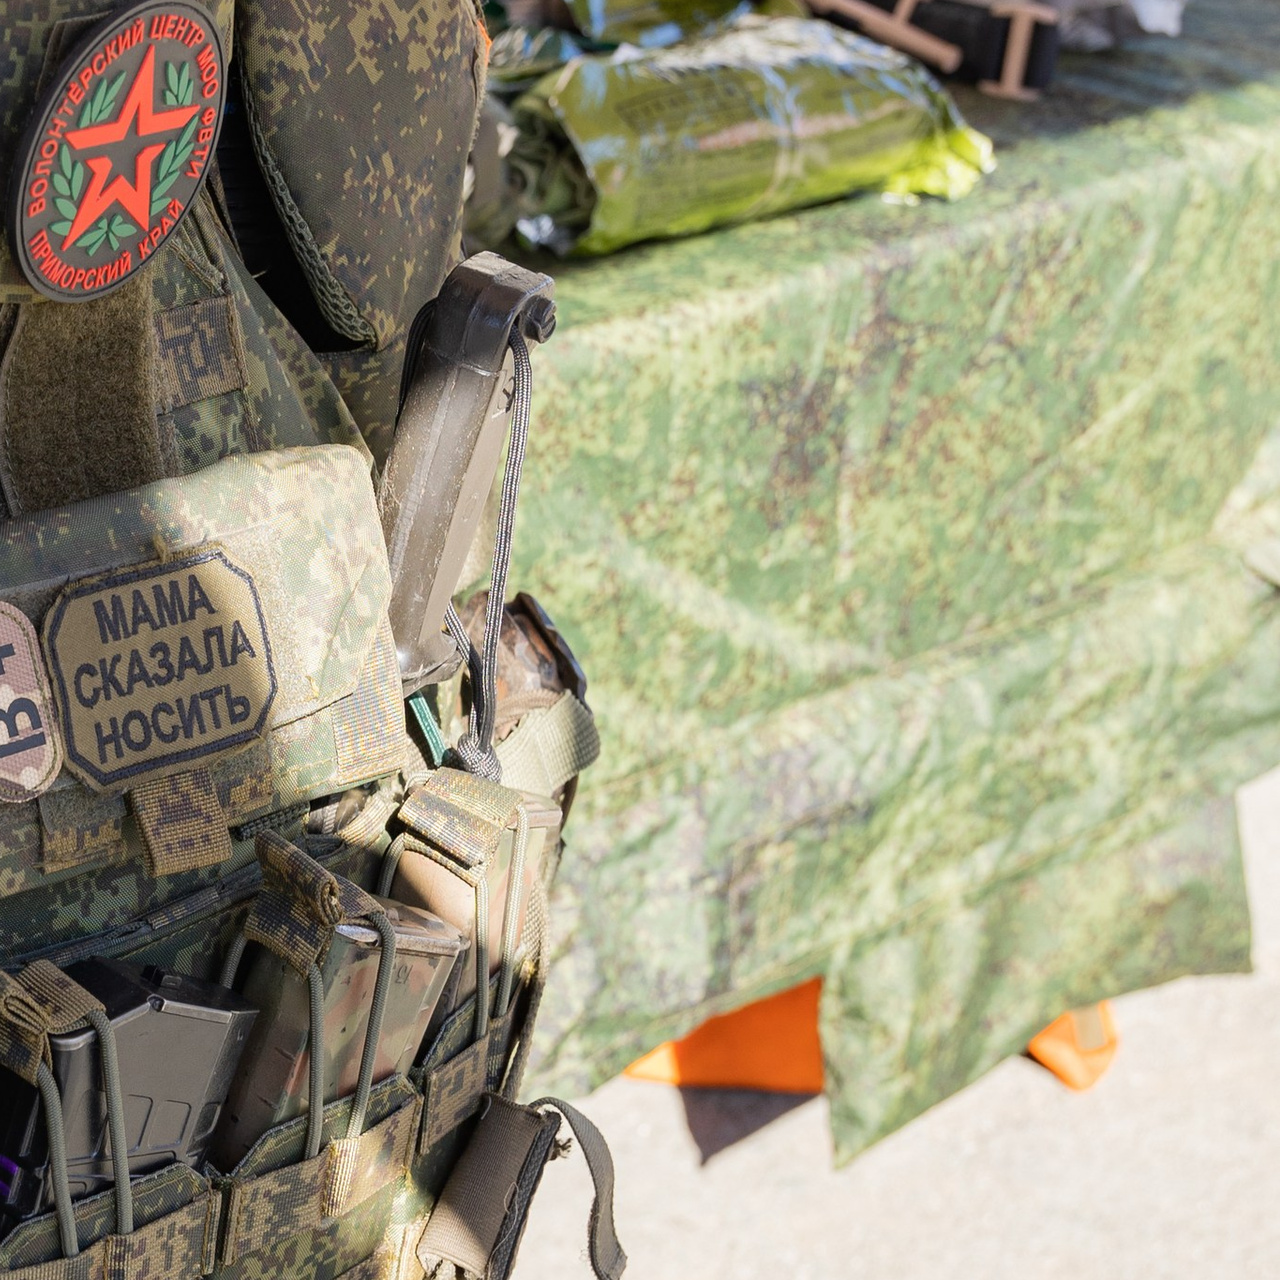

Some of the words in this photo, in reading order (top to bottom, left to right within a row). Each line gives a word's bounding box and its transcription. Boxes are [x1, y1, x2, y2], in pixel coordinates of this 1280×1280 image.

[150, 14, 205, 48] ЦЕНТР
[196, 44, 218, 99] МОО
[28, 18, 145, 218] ВОЛОНТЁРСКИЙ
[186, 107, 216, 179] ФВТИ
[29, 229, 132, 291] ПРИМОРСКИЙ
[138, 197, 184, 260] КРАЙ
[93, 574, 216, 645] МАМА
[74, 620, 256, 709] СКАЗАЛА
[94, 683, 251, 765] НОСИТЬ
